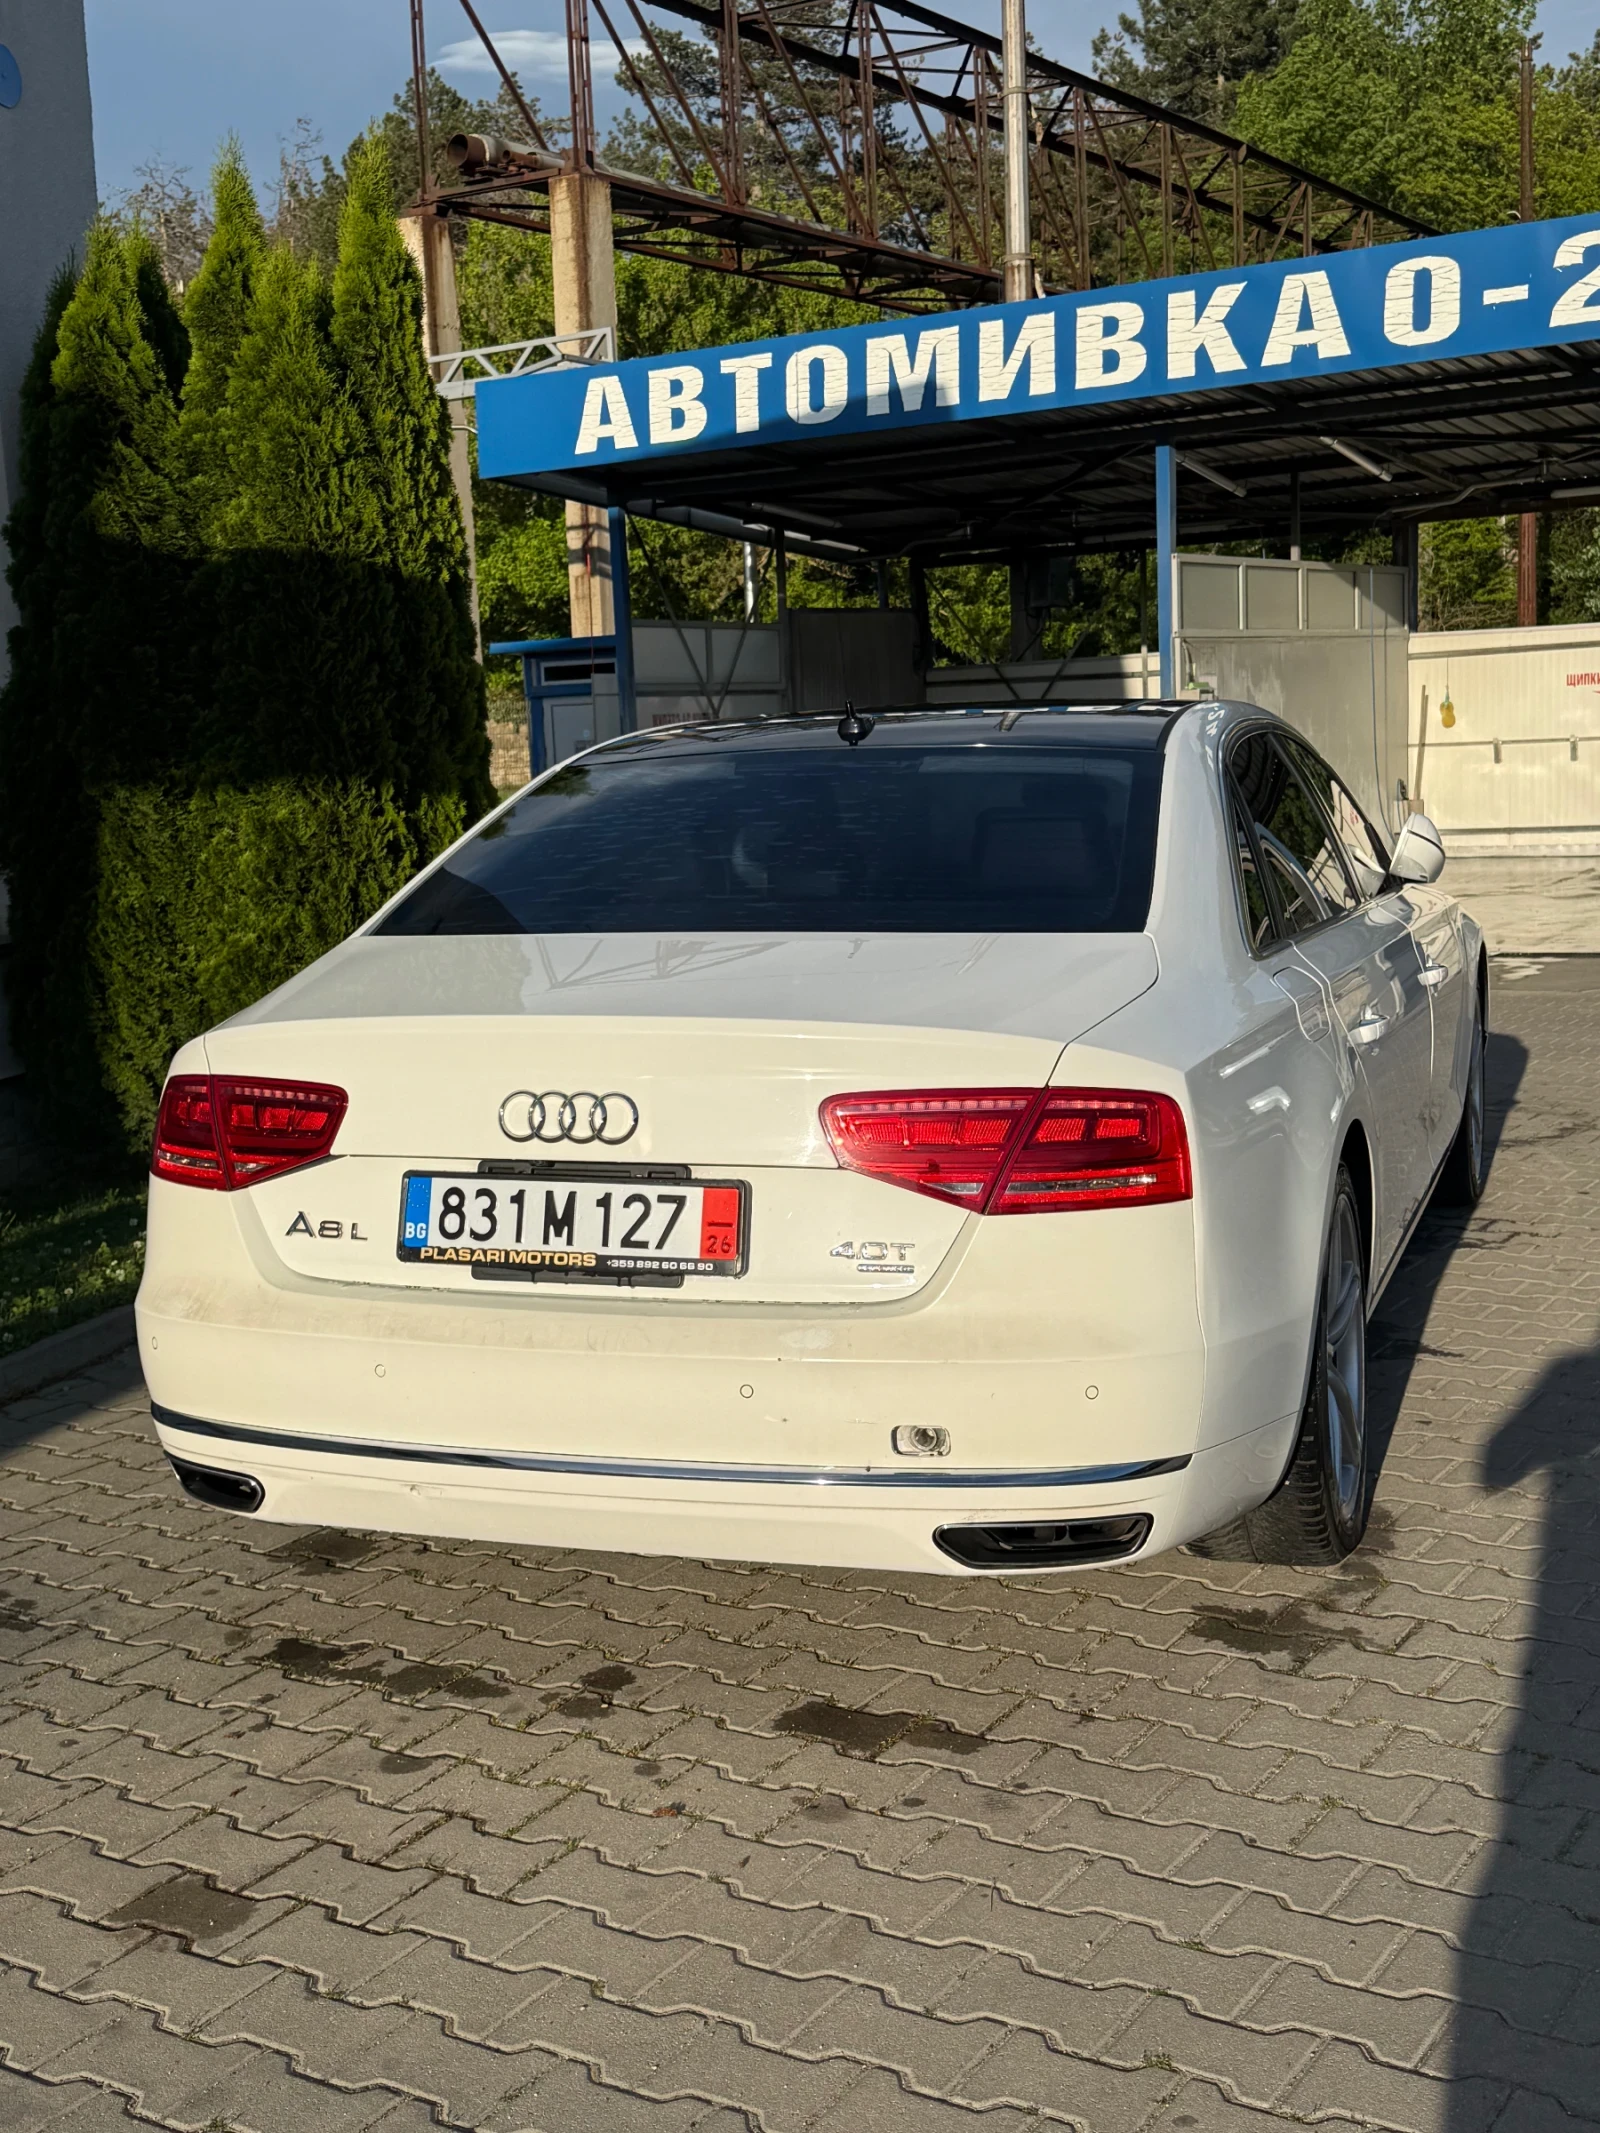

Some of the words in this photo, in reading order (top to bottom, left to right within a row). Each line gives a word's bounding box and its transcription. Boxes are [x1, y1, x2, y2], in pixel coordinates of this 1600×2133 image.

[575, 271, 1351, 455] АВТОМИВКА
[439, 1187, 526, 1244] 831
[542, 1190, 577, 1246] M
[595, 1192, 687, 1249] 127
[405, 1222, 427, 1239] BG
[707, 1235, 732, 1254] 26
[420, 1247, 505, 1263] PLASARI
[509, 1250, 596, 1267] MOTORS
[607, 1260, 634, 1268] +359
[636, 1261, 660, 1269] 892
[661, 1261, 678, 1270] 60
[697, 1262, 714, 1271] 90
